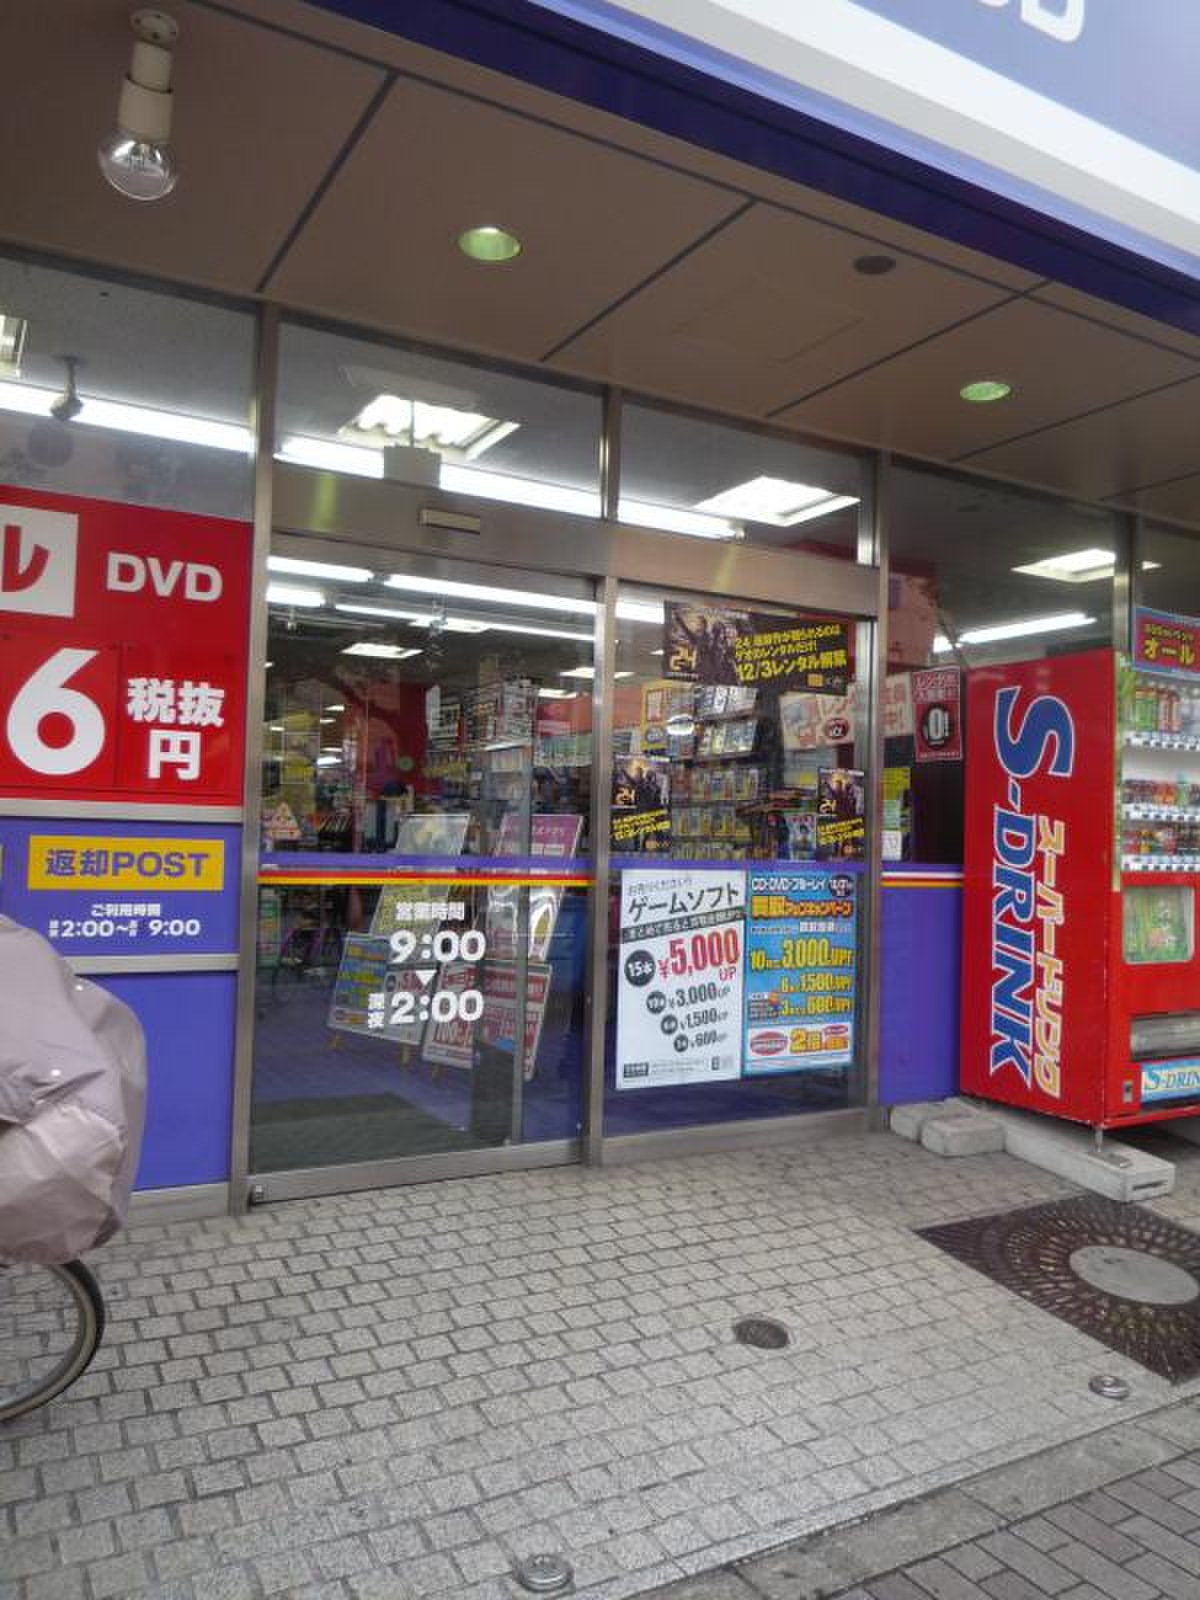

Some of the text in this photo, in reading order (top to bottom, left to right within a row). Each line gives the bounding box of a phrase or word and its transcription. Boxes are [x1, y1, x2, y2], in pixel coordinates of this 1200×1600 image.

[106, 551, 223, 602] DVD
[670, 641, 697, 672] 24
[6, 648, 106, 775] 6
[127, 678, 225, 727] 税抜
[148, 729, 201, 780] 円
[45, 849, 209, 877] 返却POST
[990, 685, 1076, 1089] S-DRINK
[91, 903, 161, 917] ご利用時間
[395, 901, 464, 921] 営業時間
[627, 882, 740, 922] ゲームソフト
[389, 929, 486, 963] 9:00
[657, 928, 740, 979] ¥5,000
[1033, 814, 1066, 1098] スーパードリンク
